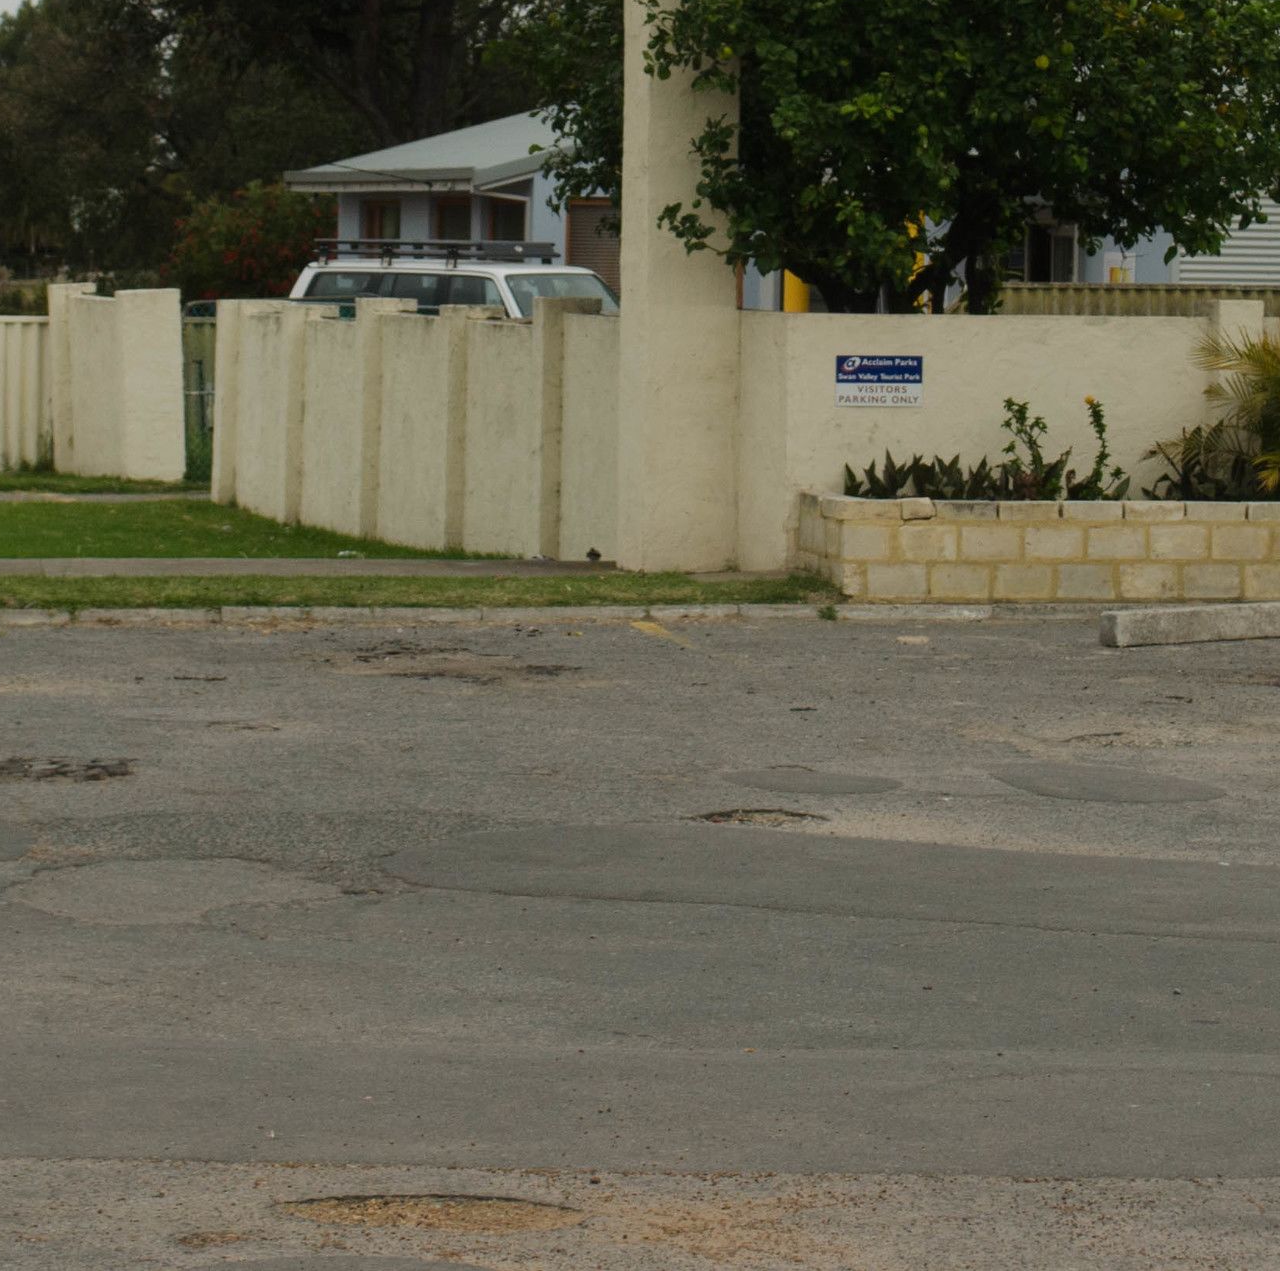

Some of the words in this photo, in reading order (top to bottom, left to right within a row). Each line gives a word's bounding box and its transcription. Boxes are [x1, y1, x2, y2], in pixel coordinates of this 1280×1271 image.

[861, 358, 893, 366] Acclaim
[894, 358, 918, 366] Parks
[857, 385, 908, 394] VISITORS
[838, 395, 887, 404] PARKING
[891, 395, 920, 404] ONLY
